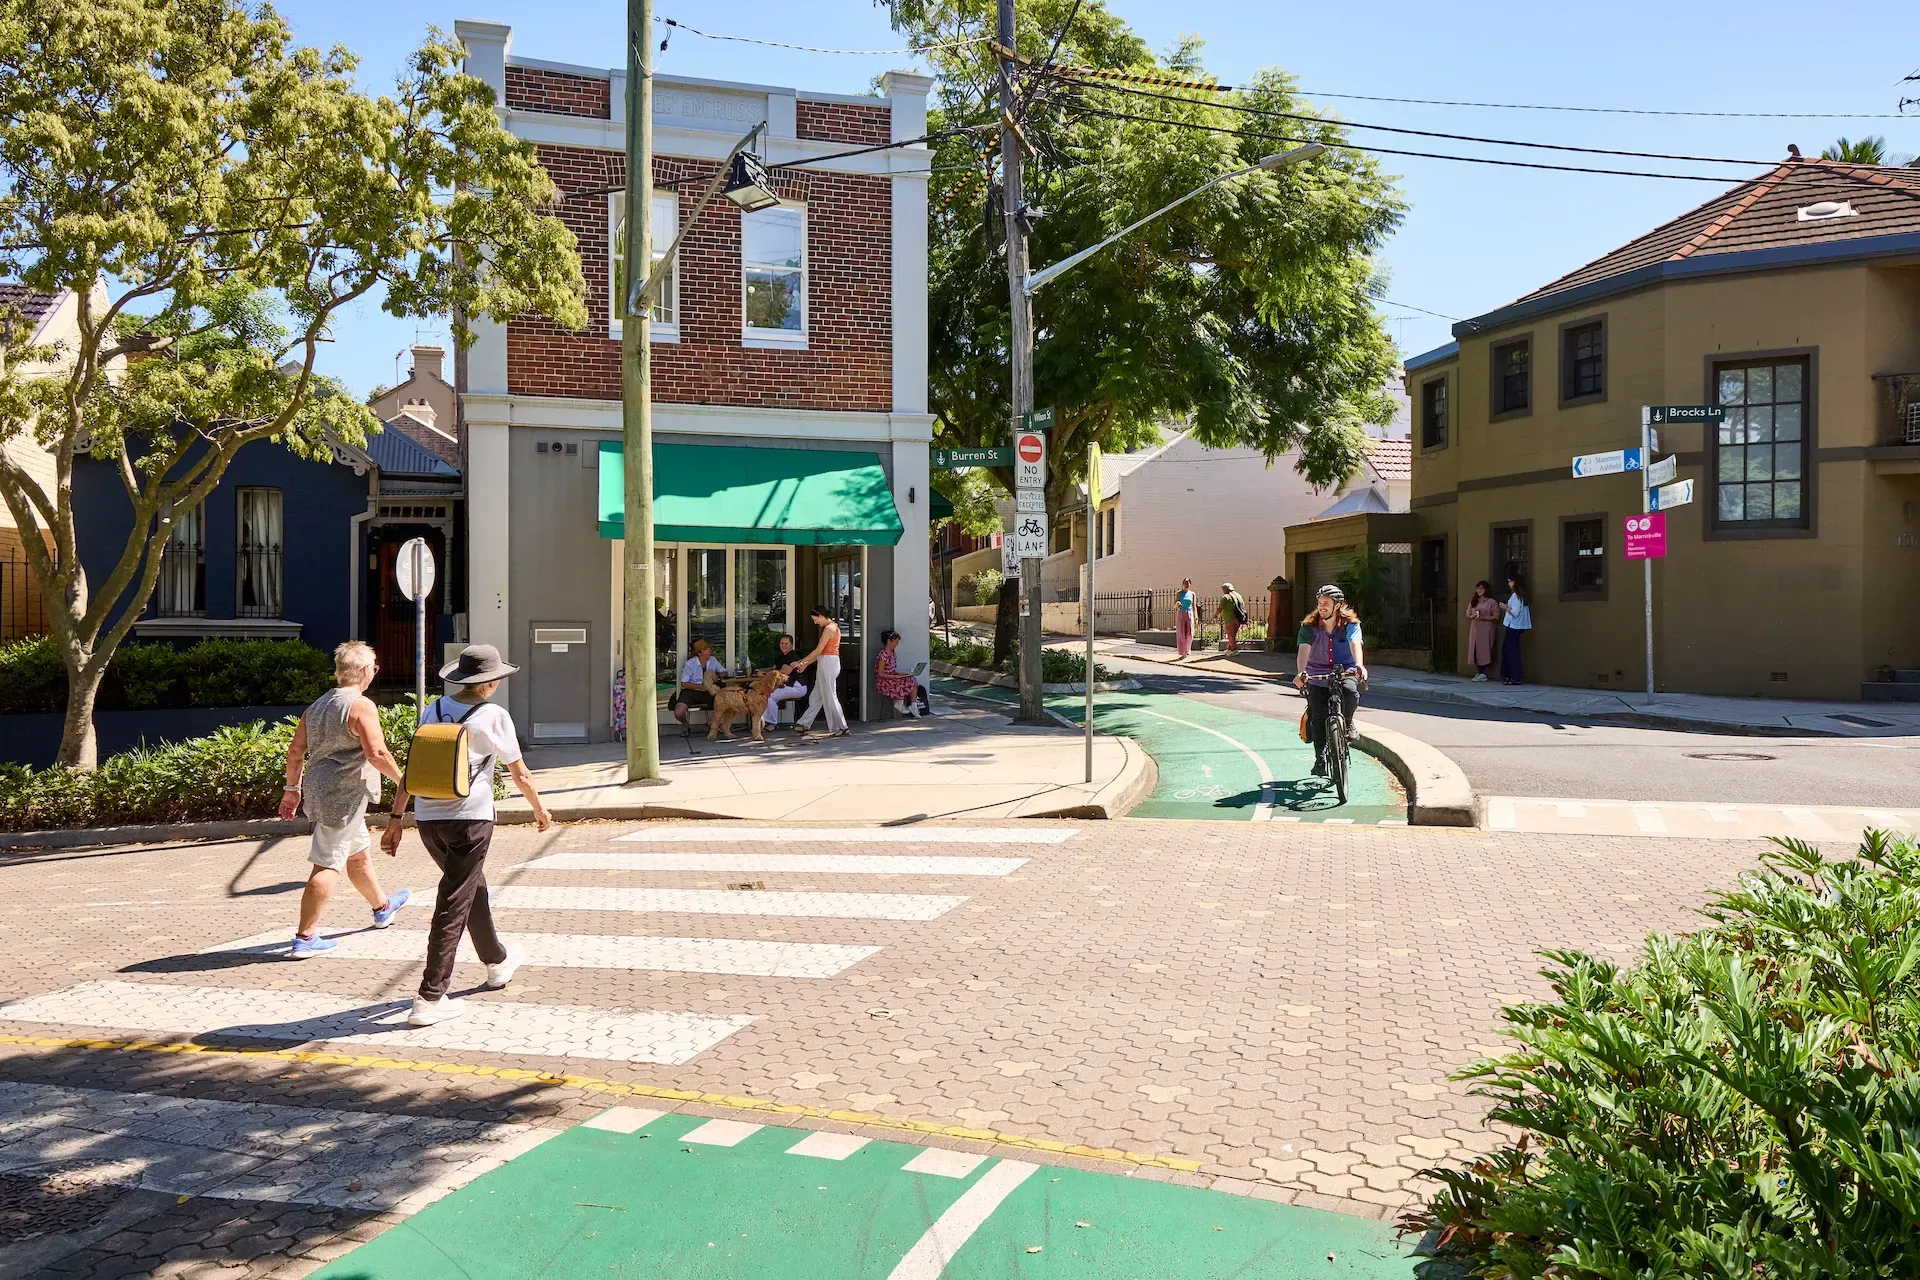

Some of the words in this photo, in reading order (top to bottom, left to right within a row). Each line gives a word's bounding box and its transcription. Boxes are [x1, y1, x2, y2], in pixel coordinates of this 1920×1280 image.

[1046, 410, 1052, 420] St
[1670, 407, 1706, 417] Brocks
[1708, 407, 1721, 416] Ln
[951, 451, 986, 461] Burren
[988, 450, 998, 460] St
[1595, 455, 1622, 464] Stanmore
[1024, 465, 1038, 474] NO
[1599, 462, 1622, 472] Ashfield
[1020, 476, 1042, 484] ENTRY
[1018, 501, 1044, 509] EXCEPTED
[1633, 532, 1662, 540] Marrickville
[1018, 541, 1044, 552] LANE
